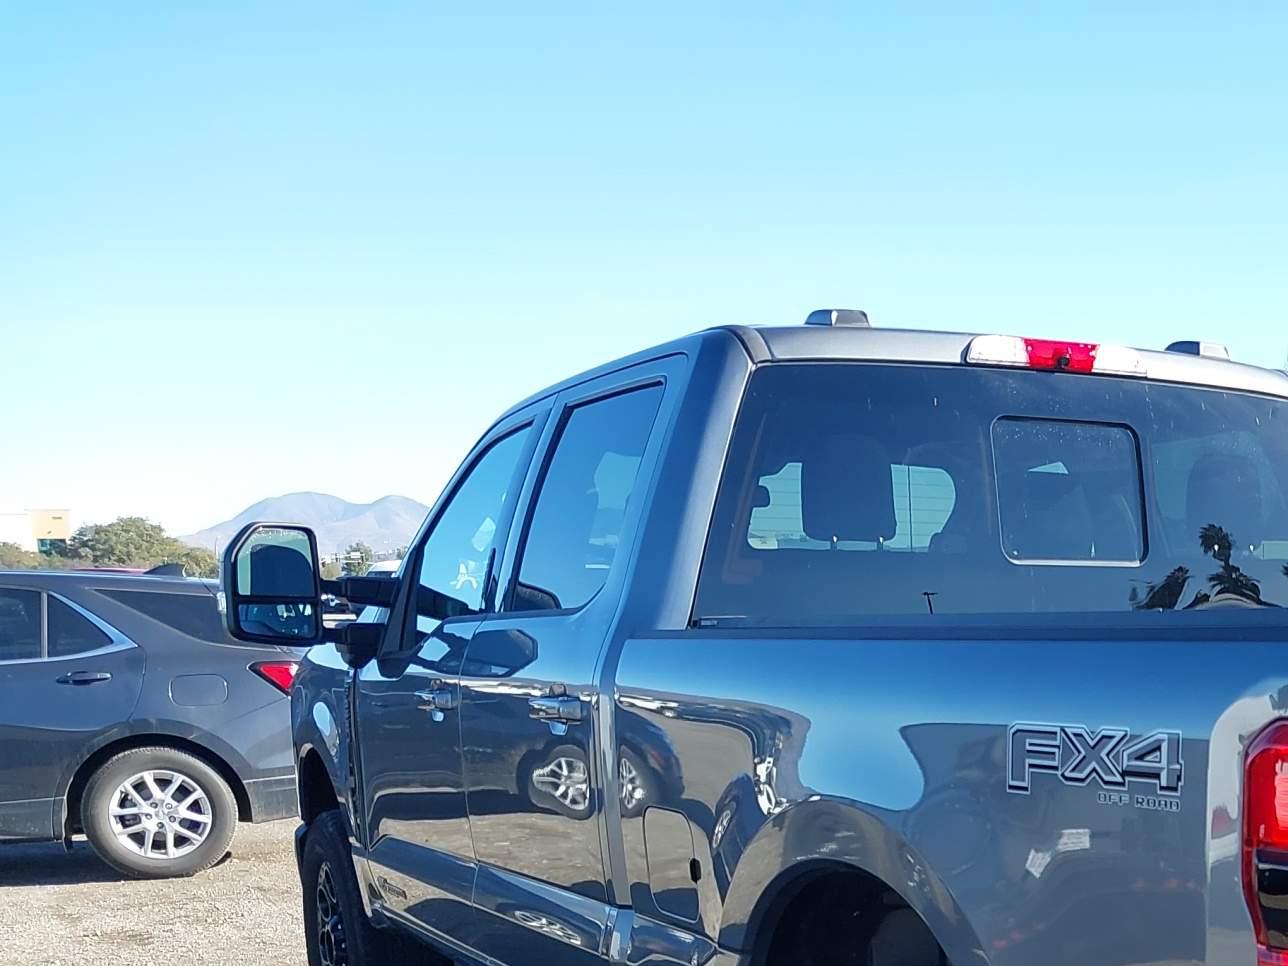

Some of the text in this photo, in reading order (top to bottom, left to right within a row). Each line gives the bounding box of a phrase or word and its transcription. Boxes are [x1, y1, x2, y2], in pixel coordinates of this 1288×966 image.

[1006, 721, 1184, 796] FX4
[1097, 791, 1181, 812] OFF ROAD
